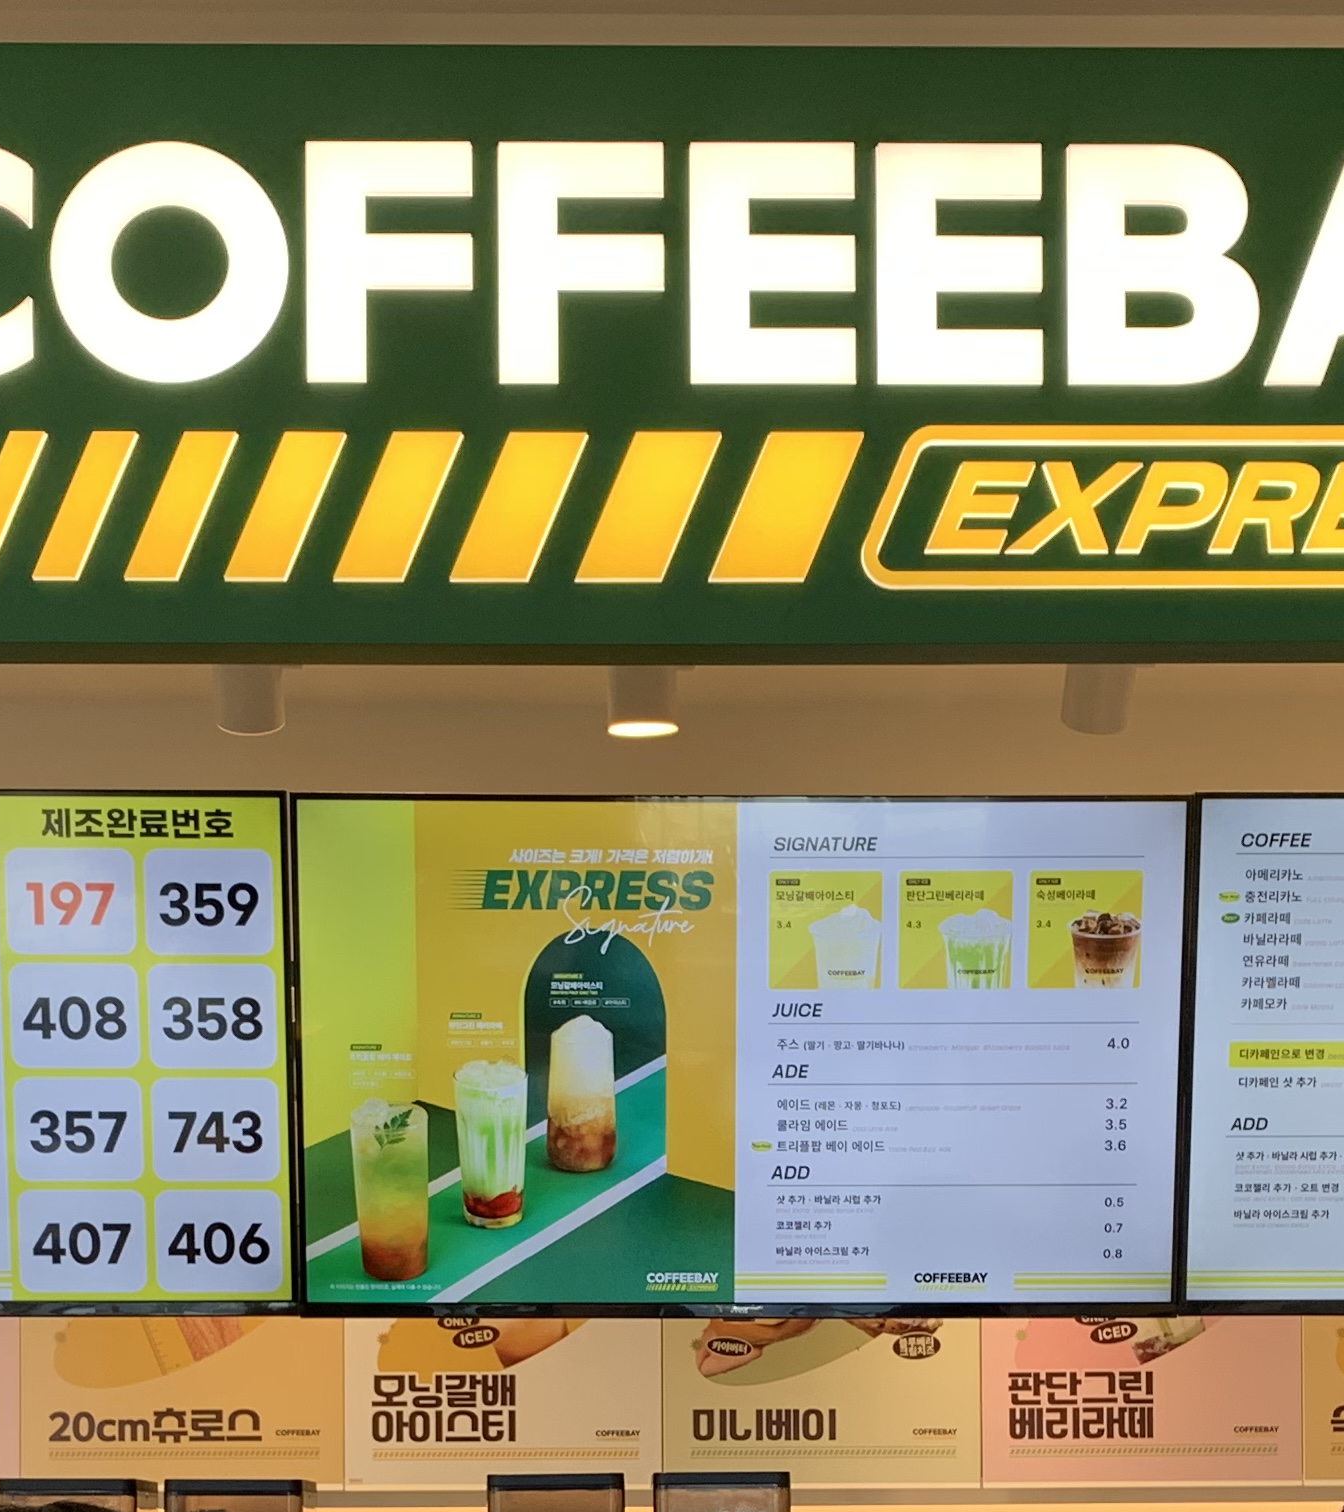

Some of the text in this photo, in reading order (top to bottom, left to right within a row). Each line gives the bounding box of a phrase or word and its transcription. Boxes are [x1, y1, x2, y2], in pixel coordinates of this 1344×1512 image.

[41, 808, 235, 839] 제조완료번호
[773, 836, 878, 852] SIGNATURE
[1241, 833, 1312, 848] COFFEE
[509, 849, 565, 863] 사이즈는
[569, 850, 603, 863] 크게!
[606, 850, 648, 864] 가격은
[1246, 869, 1303, 882] 아메리카노
[482, 870, 714, 911] EXPRESS
[776, 890, 854, 901] 모닝갈배아이스티
[1036, 889, 1096, 901] 숙성베이라떼
[25, 882, 115, 926] 197
[159, 882, 260, 927] 359
[563, 885, 695, 954] Signature
[776, 920, 792, 929] 3.4
[906, 920, 922, 929] 4.3
[1036, 919, 1052, 929] 3.4
[1244, 912, 1291, 925] 카페라떼
[1243, 933, 1302, 946] 바닐라라떼
[1242, 955, 1289, 968] 연유라떼
[1241, 976, 1301, 989] 카라멜라떼
[772, 1002, 823, 1019] JUICE
[1241, 998, 1287, 1010] 카페모카
[23, 996, 127, 1040] 408
[162, 997, 264, 1041] 358
[1239, 1047, 1301, 1061] 디카페인으로
[1304, 1047, 1325, 1060] 변경
[772, 1064, 809, 1079] ADE
[777, 1118, 1127, 1133] 쿨라임 에이드 3.5
[1231, 1117, 1268, 1131] ADD
[30, 1110, 128, 1154] 357
[168, 1111, 264, 1154] 743
[776, 1139, 1127, 1153] 트리플팝 베이 에이드 3.6
[771, 1165, 810, 1180] ADD
[32, 1223, 132, 1264] 407
[167, 1222, 271, 1264] 406
[646, 1272, 719, 1284] COFFEEBAY
[914, 1272, 988, 1284] COFFEEBAY
[444, 1318, 473, 1327] ONLY
[460, 1329, 493, 1345] ICED
[1098, 1324, 1131, 1340] ICED
[372, 1375, 516, 1408] 모닝갈배
[1008, 1371, 1154, 1405] 판단그린
[372, 1410, 516, 1442] 아이스티
[693, 1408, 836, 1441] 미니베이
[1009, 1406, 1154, 1440] 베리라떼
[1233, 1425, 1279, 1434] COFFEEBAY
